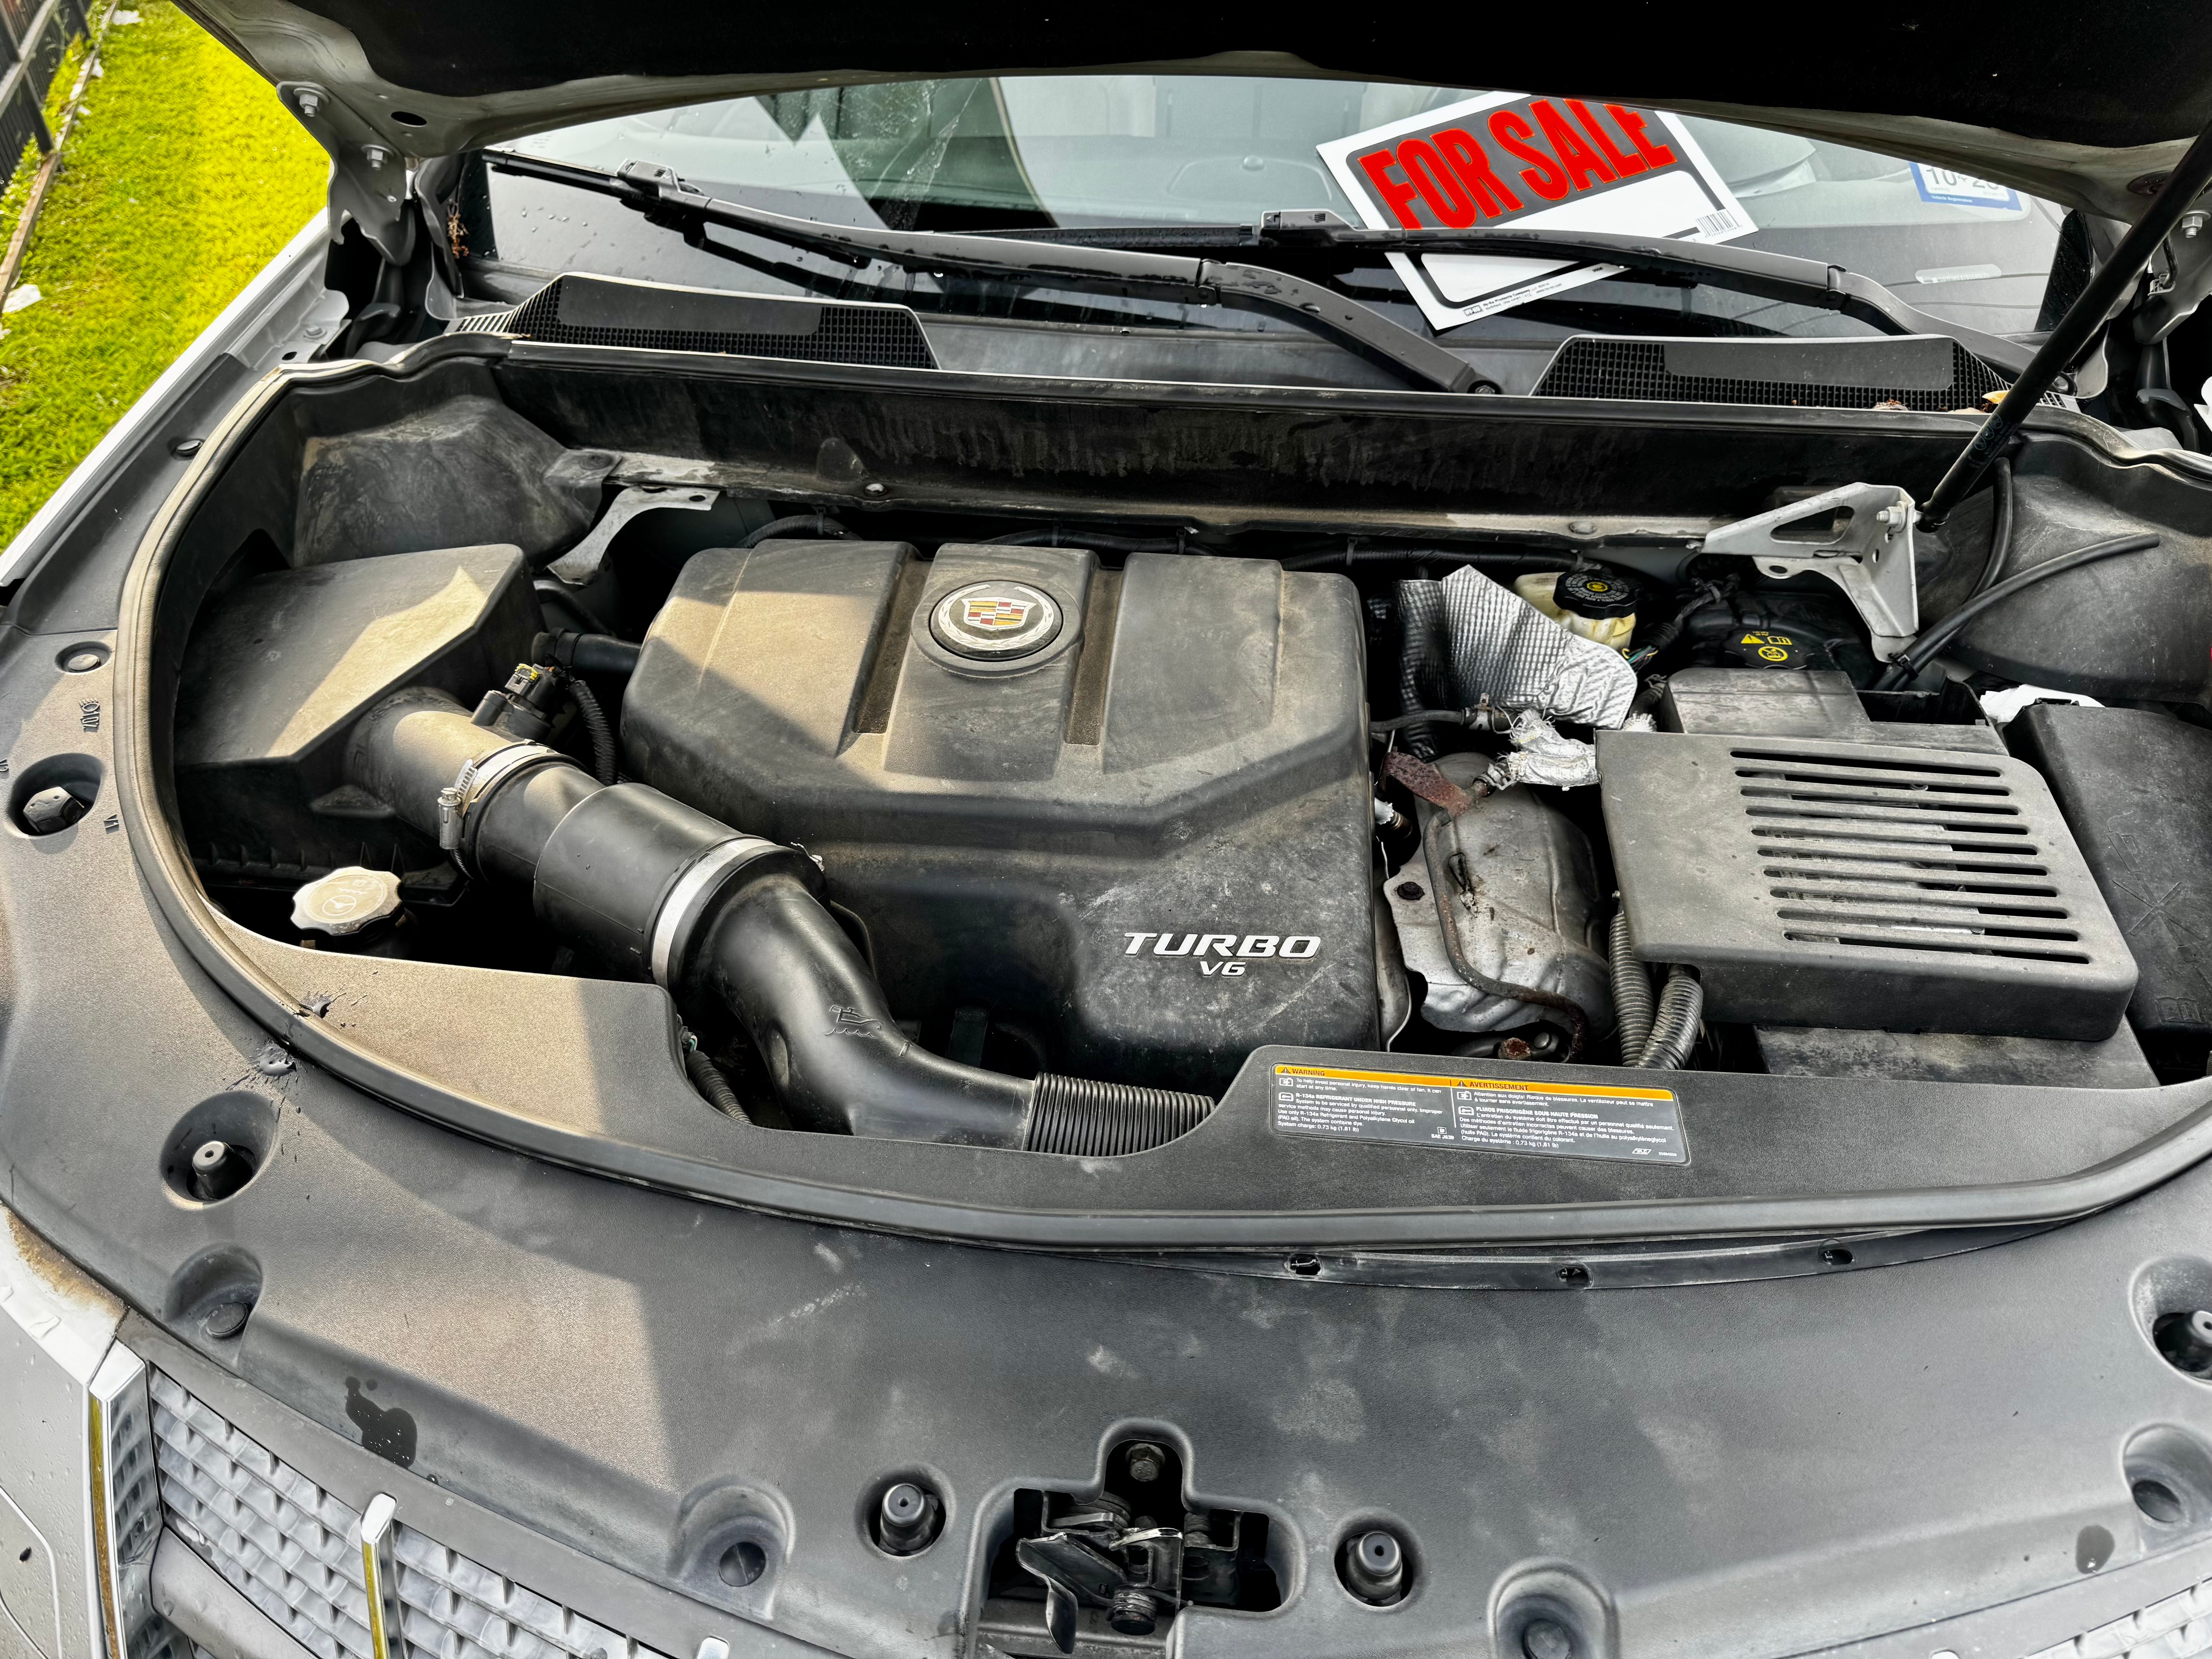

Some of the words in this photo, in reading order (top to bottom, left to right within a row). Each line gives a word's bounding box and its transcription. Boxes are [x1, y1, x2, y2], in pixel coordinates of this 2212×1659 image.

[1358, 128, 1524, 230] FOR
[1488, 99, 1676, 201] SALE
[1124, 933, 1321, 958] TURBO
[1200, 961, 1246, 976] V6
[1470, 1082, 1529, 1090] AVERTISSEMENT
[1360, 1114, 1391, 1122] Polyalkylene
